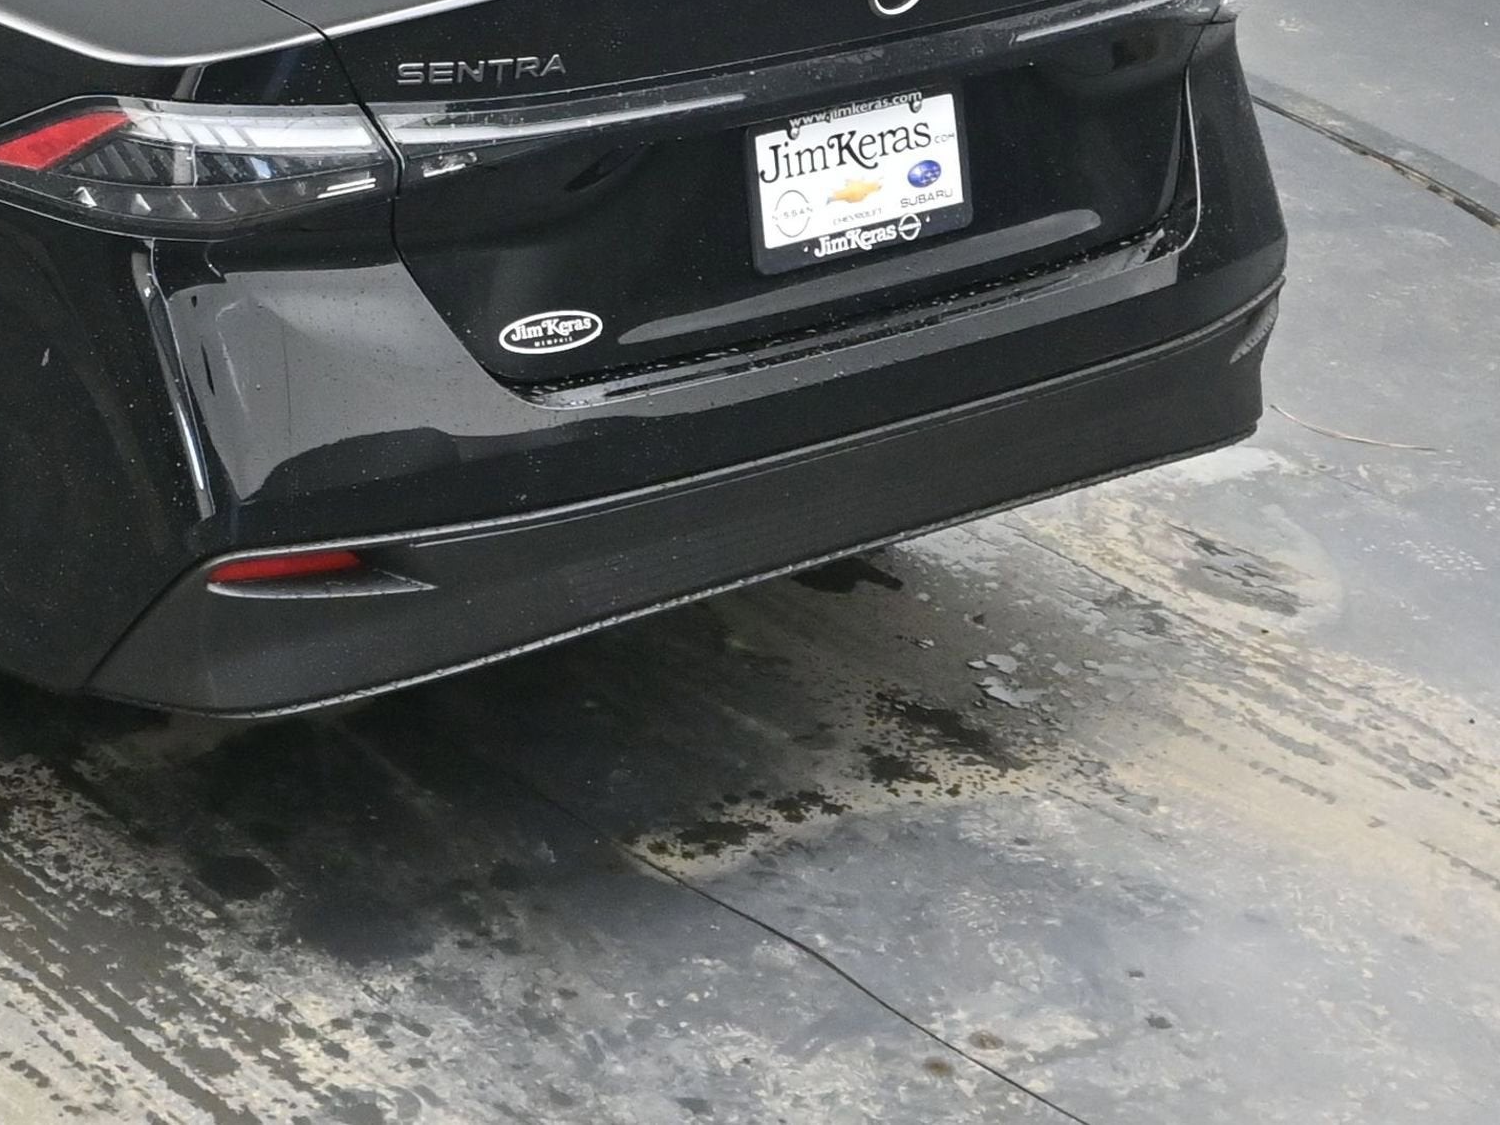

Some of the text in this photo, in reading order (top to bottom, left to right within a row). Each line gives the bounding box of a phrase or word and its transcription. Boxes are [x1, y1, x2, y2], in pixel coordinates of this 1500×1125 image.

[398, 54, 567, 86] SENTRA
[789, 91, 922, 128] www.jimkeras.com
[900, 188, 953, 208] SUBARU
[771, 206, 813, 221] NSSAN
